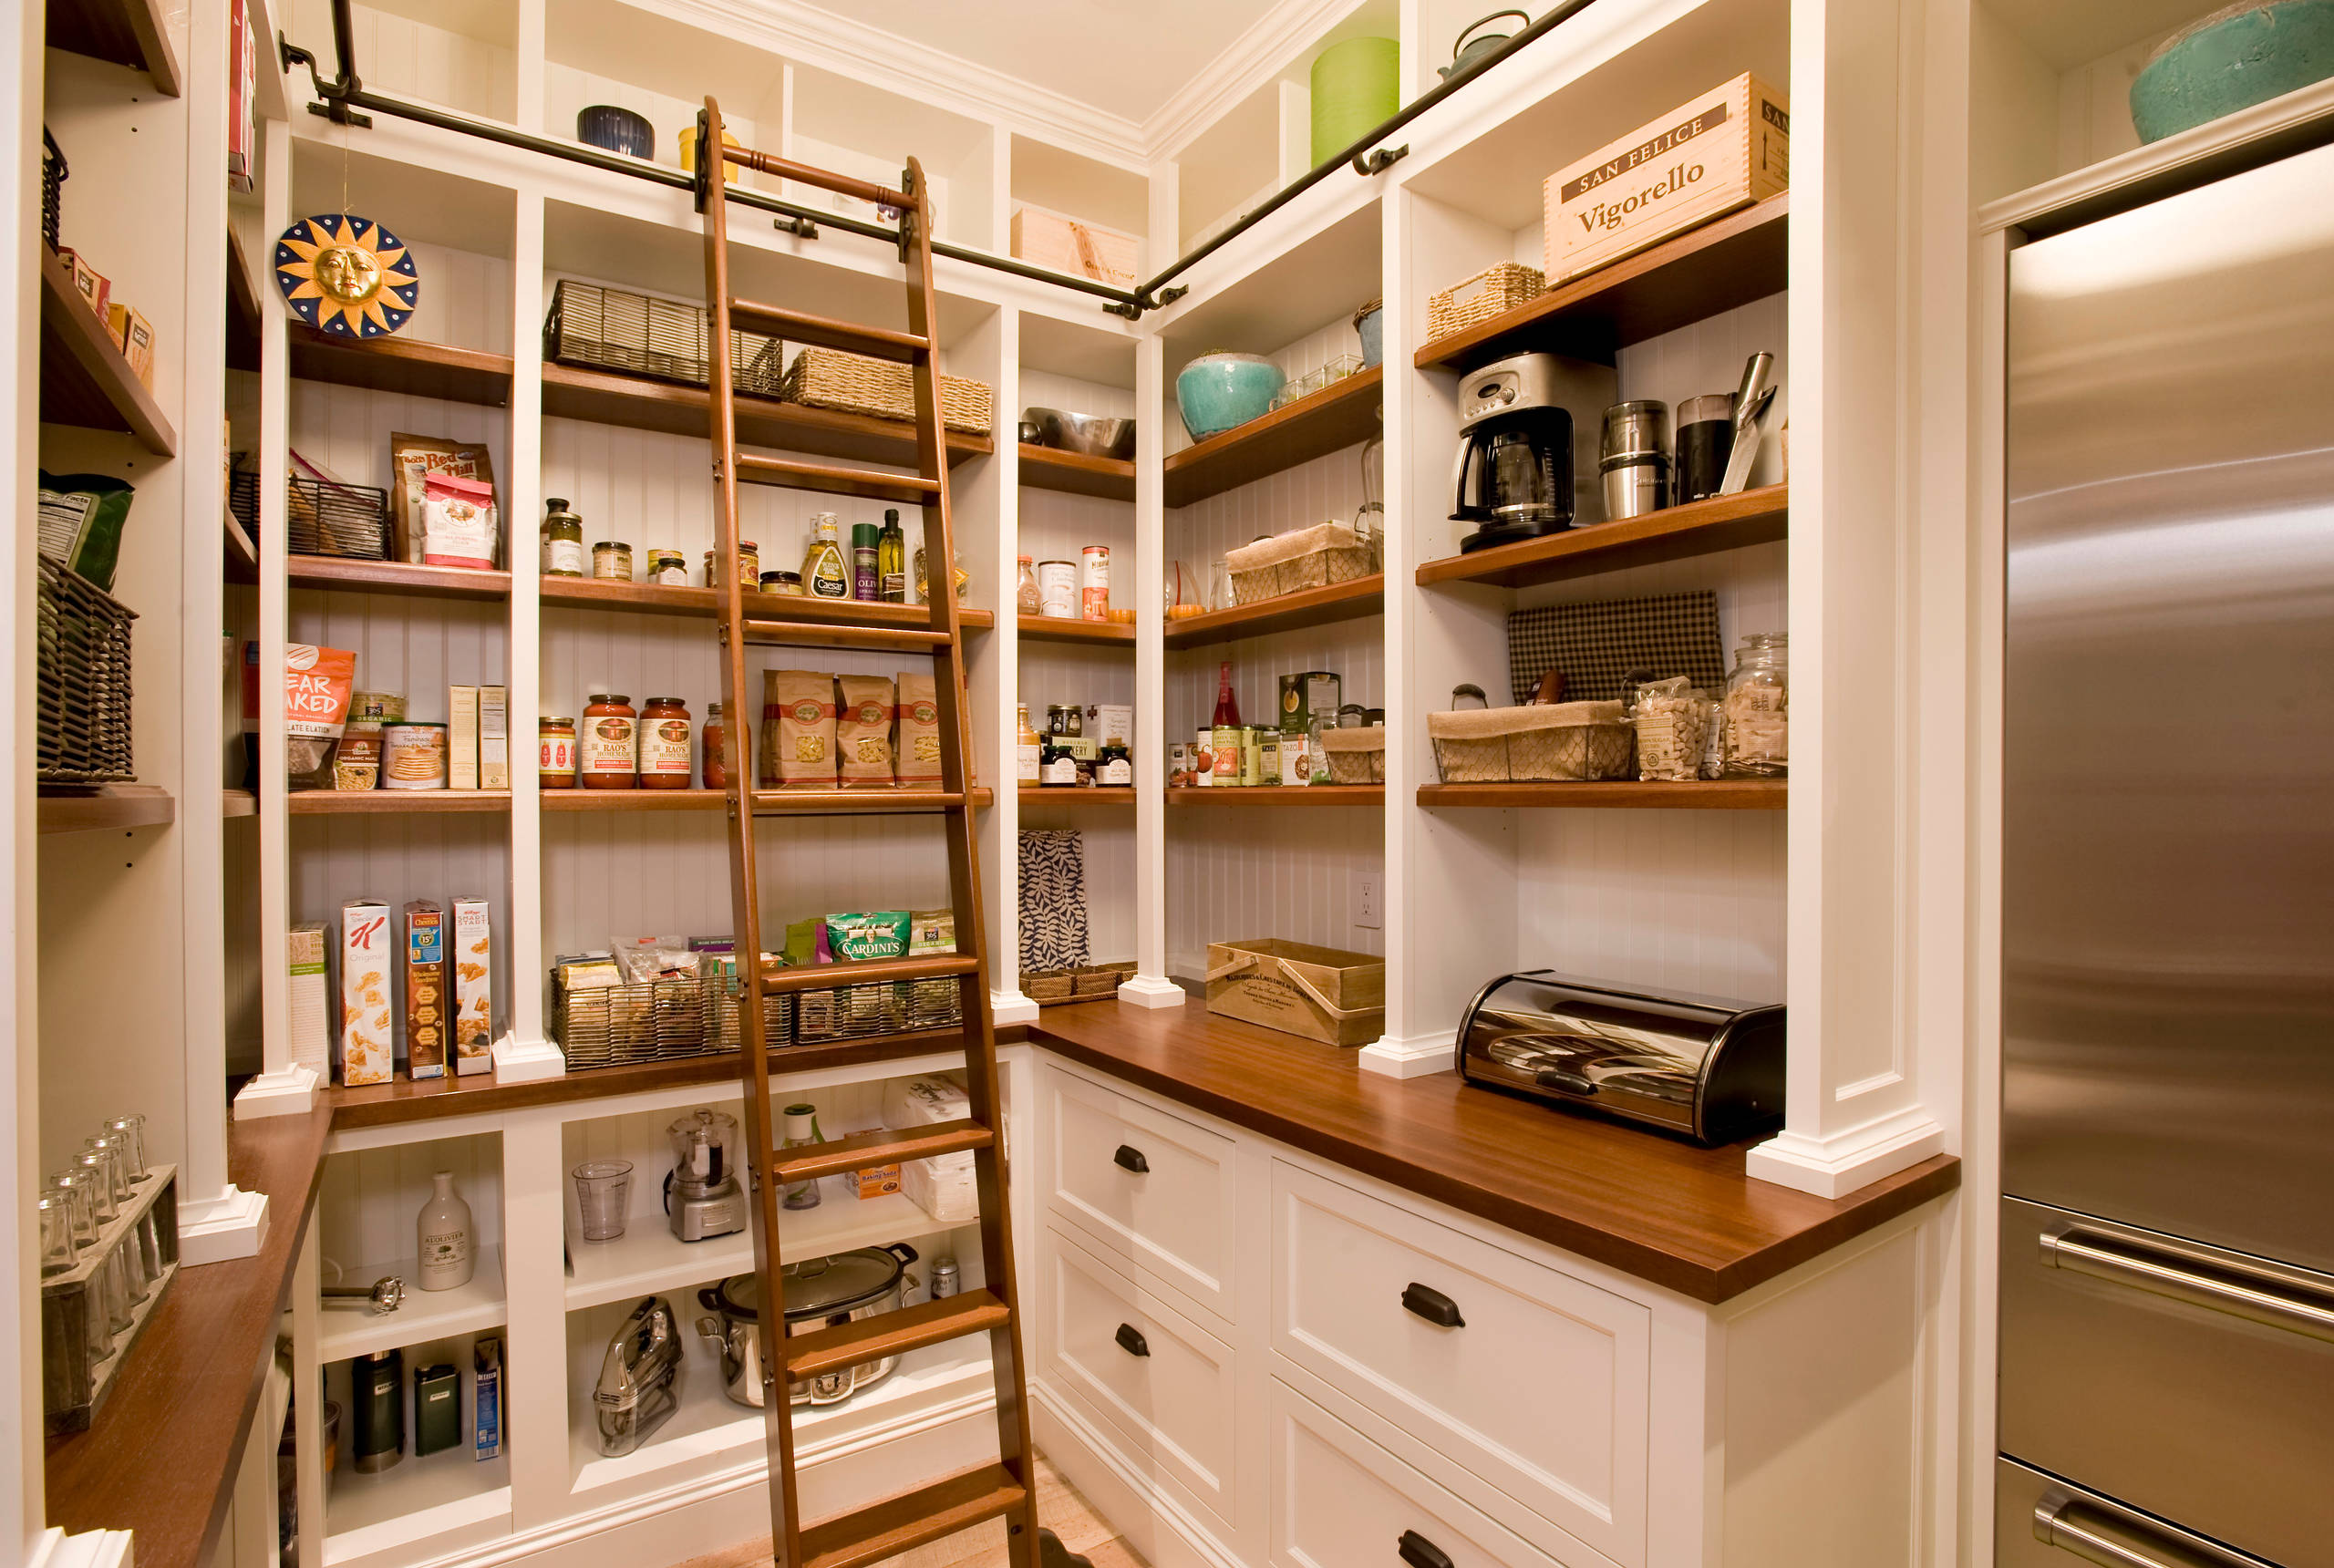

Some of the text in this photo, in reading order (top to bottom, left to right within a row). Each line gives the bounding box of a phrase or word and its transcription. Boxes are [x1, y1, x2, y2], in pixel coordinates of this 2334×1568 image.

[1580, 119, 1703, 192] SAN FELICE
[1578, 162, 1705, 233] Vigorello
[426, 451, 458, 471] Red
[442, 462, 474, 477] Mill
[818, 580, 843, 592] Caesar
[858, 580, 877, 588] OLIV
[287, 674, 331, 694] EAR
[287, 693, 338, 713] KED
[604, 744, 627, 752] RAO'S
[1070, 746, 1088, 757] KERY
[1283, 744, 1297, 752] TAZO
[349, 916, 386, 950] K
[925, 932, 937, 940] 365
[842, 942, 900, 957] CARDINI'S
[350, 953, 385, 964] Original
[862, 1173, 883, 1181] Baking
